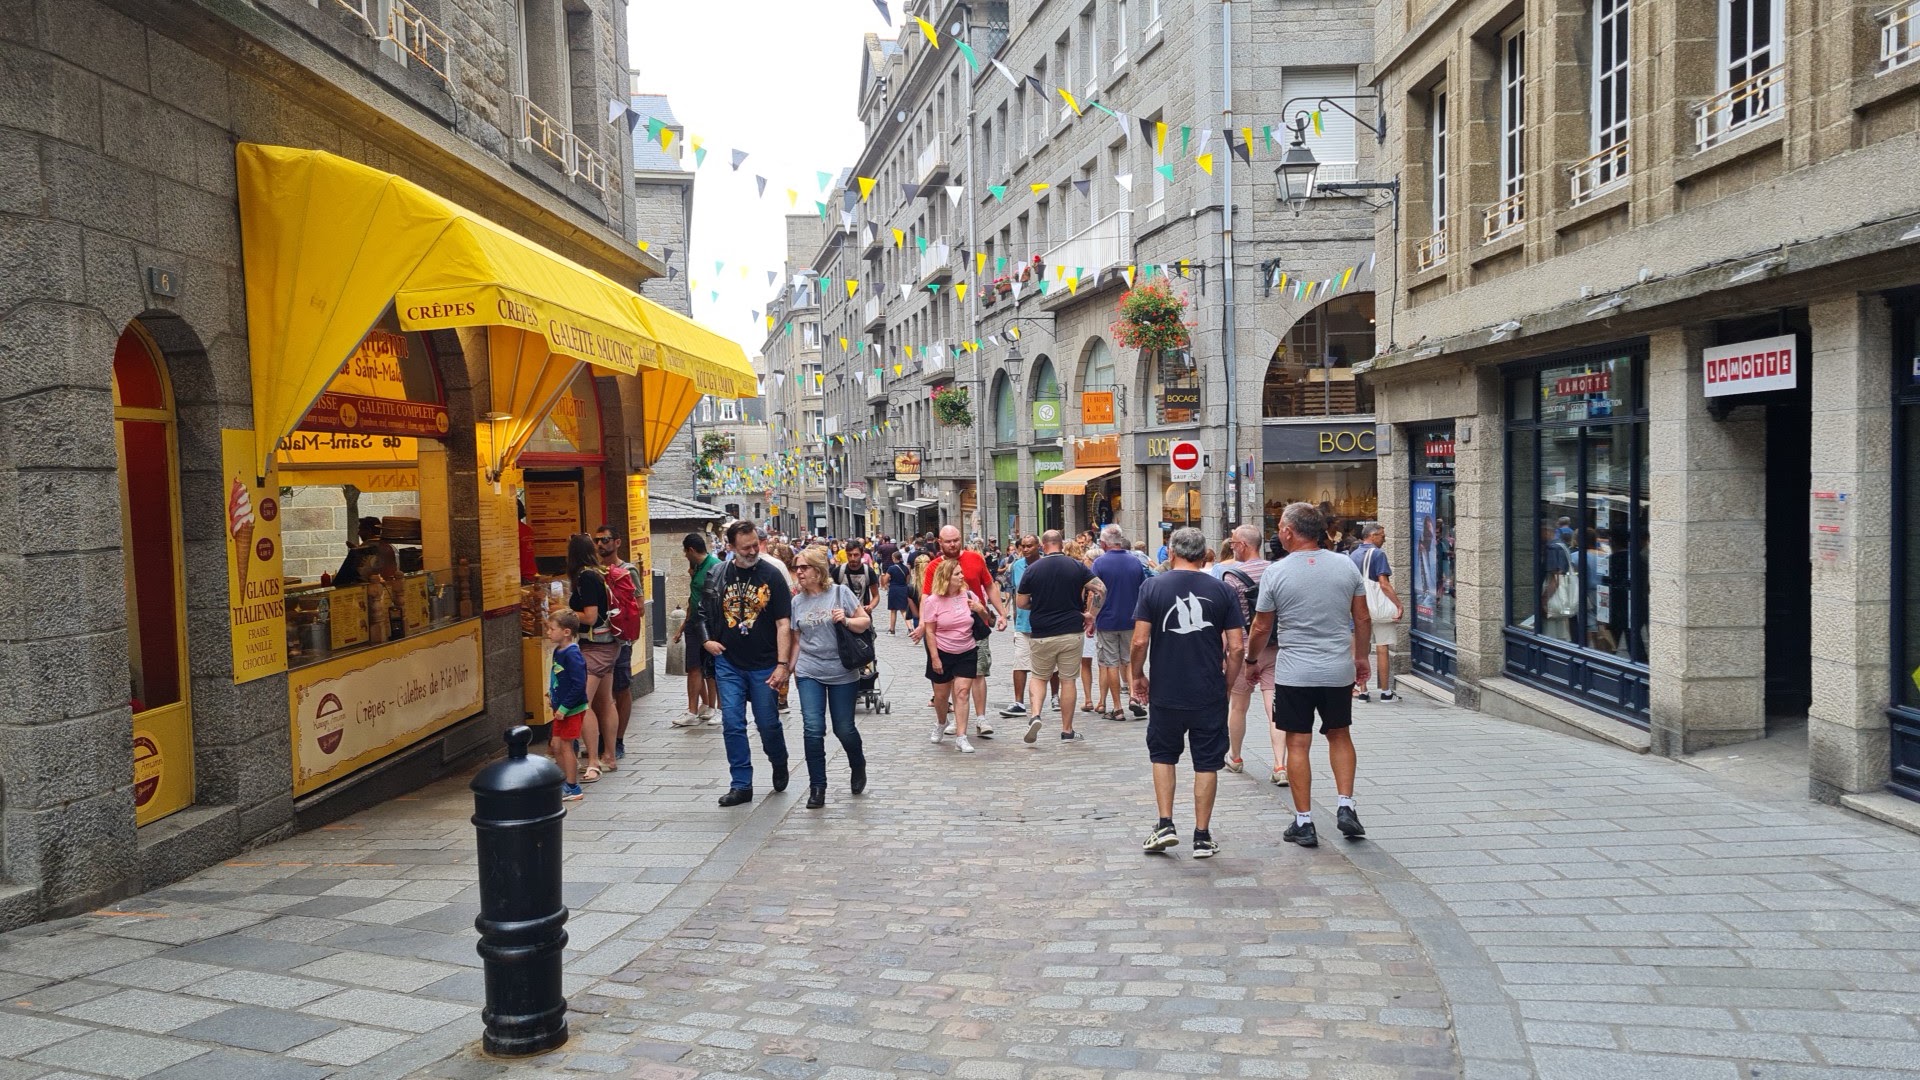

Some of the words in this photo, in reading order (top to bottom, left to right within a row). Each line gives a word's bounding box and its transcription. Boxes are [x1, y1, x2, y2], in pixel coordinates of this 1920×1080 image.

[162, 274, 170, 292] 6
[407, 302, 475, 320] CRÊPES
[497, 299, 539, 327] CRÊPES
[549, 320, 595, 356] GALETTE
[596, 334, 636, 369] SAUCISSE
[1708, 354, 1790, 380] LAMOTTE
[1558, 375, 1608, 394] LAMOTTE
[1166, 394, 1198, 403] BOCAGE
[358, 399, 396, 417] GALETTE
[398, 404, 436, 420] COMPLETE
[1416, 488, 1432, 500] LUKE
[1415, 500, 1434, 514] BERRY
[246, 578, 280, 600] GLACES
[233, 599, 284, 626] ITALIENNES
[248, 626, 270, 640] FRAISE
[246, 640, 273, 655] VANILLE
[242, 653, 278, 671] CHOCOLAT
[356, 700, 386, 728] Crêpes
[397, 679, 426, 708] Galettes
[429, 672, 439, 696] de
[440, 667, 453, 691] Blé
[453, 664, 468, 686] Noir
